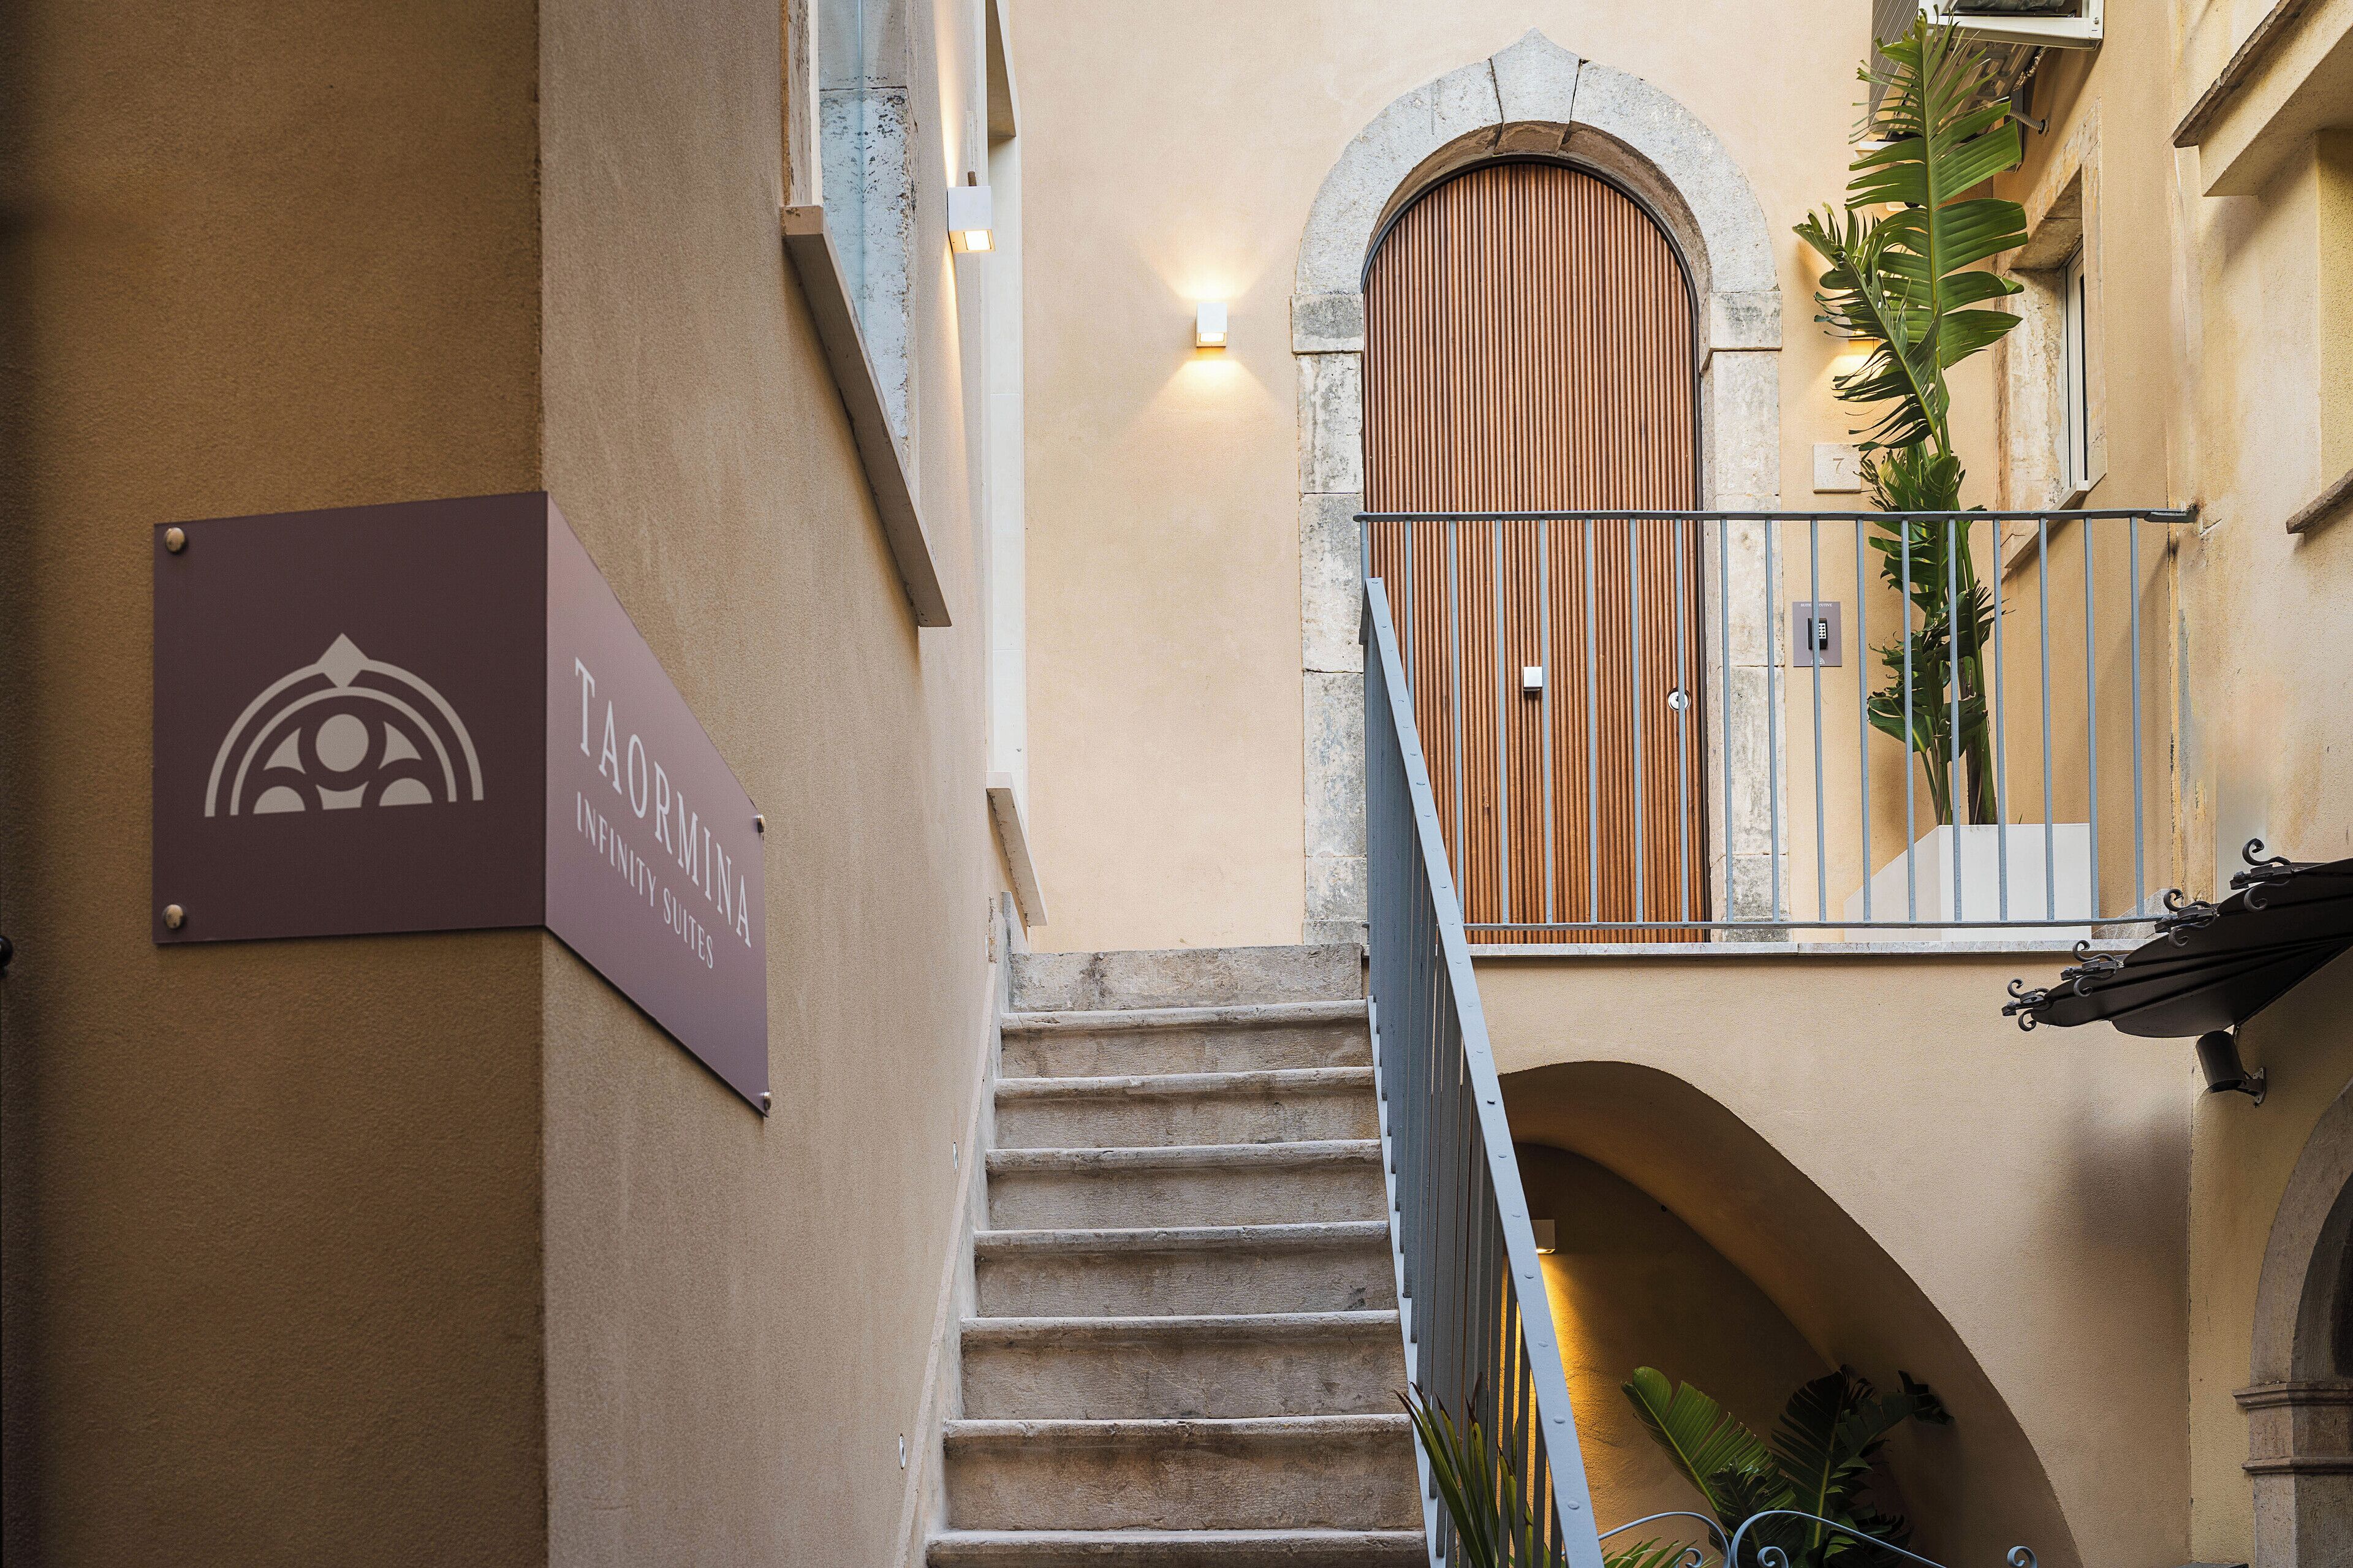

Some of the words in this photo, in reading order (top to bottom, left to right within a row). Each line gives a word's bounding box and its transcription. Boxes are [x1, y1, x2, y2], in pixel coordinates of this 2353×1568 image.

[1833, 458, 1845, 475] 7
[575, 657, 751, 949] TAORMINA
[576, 791, 656, 907] INFINITY
[663, 887, 713, 969] SUITES
